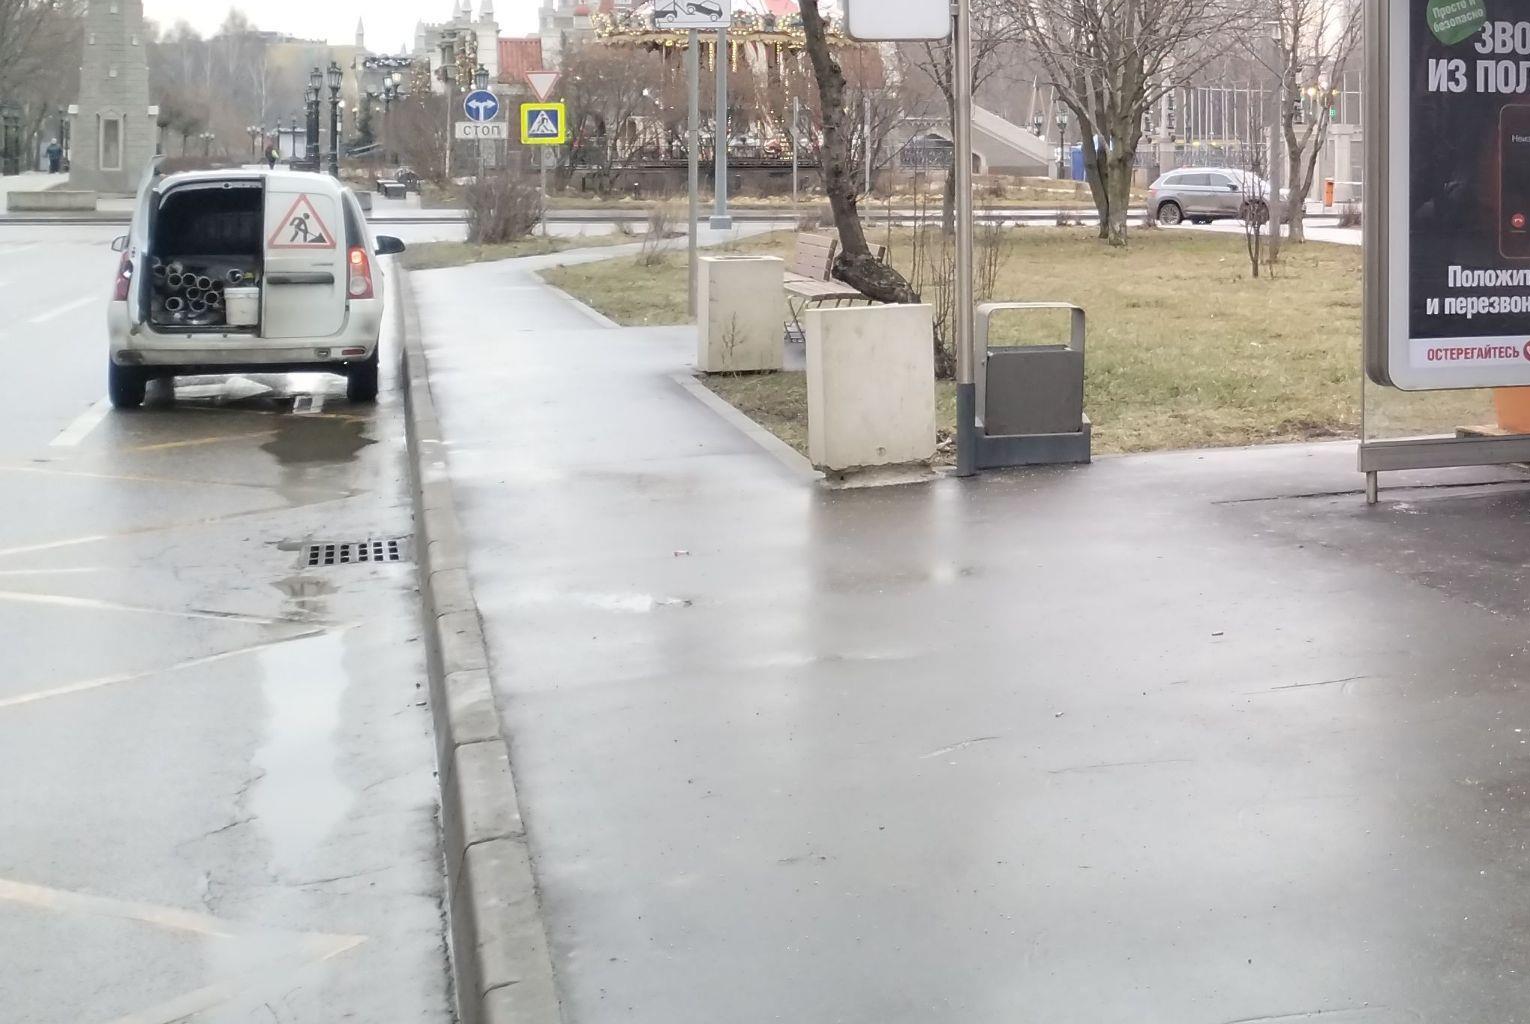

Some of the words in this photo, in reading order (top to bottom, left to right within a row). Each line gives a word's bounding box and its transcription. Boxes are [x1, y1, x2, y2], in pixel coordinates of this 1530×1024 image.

[1433, 8, 1484, 33] безопасно
[1428, 58, 1467, 93] ИЗ
[463, 125, 501, 136] СТОП
[1426, 297, 1439, 315] и
[1427, 344, 1520, 361] ОСТЕРЕГАЙТЕСЬ
